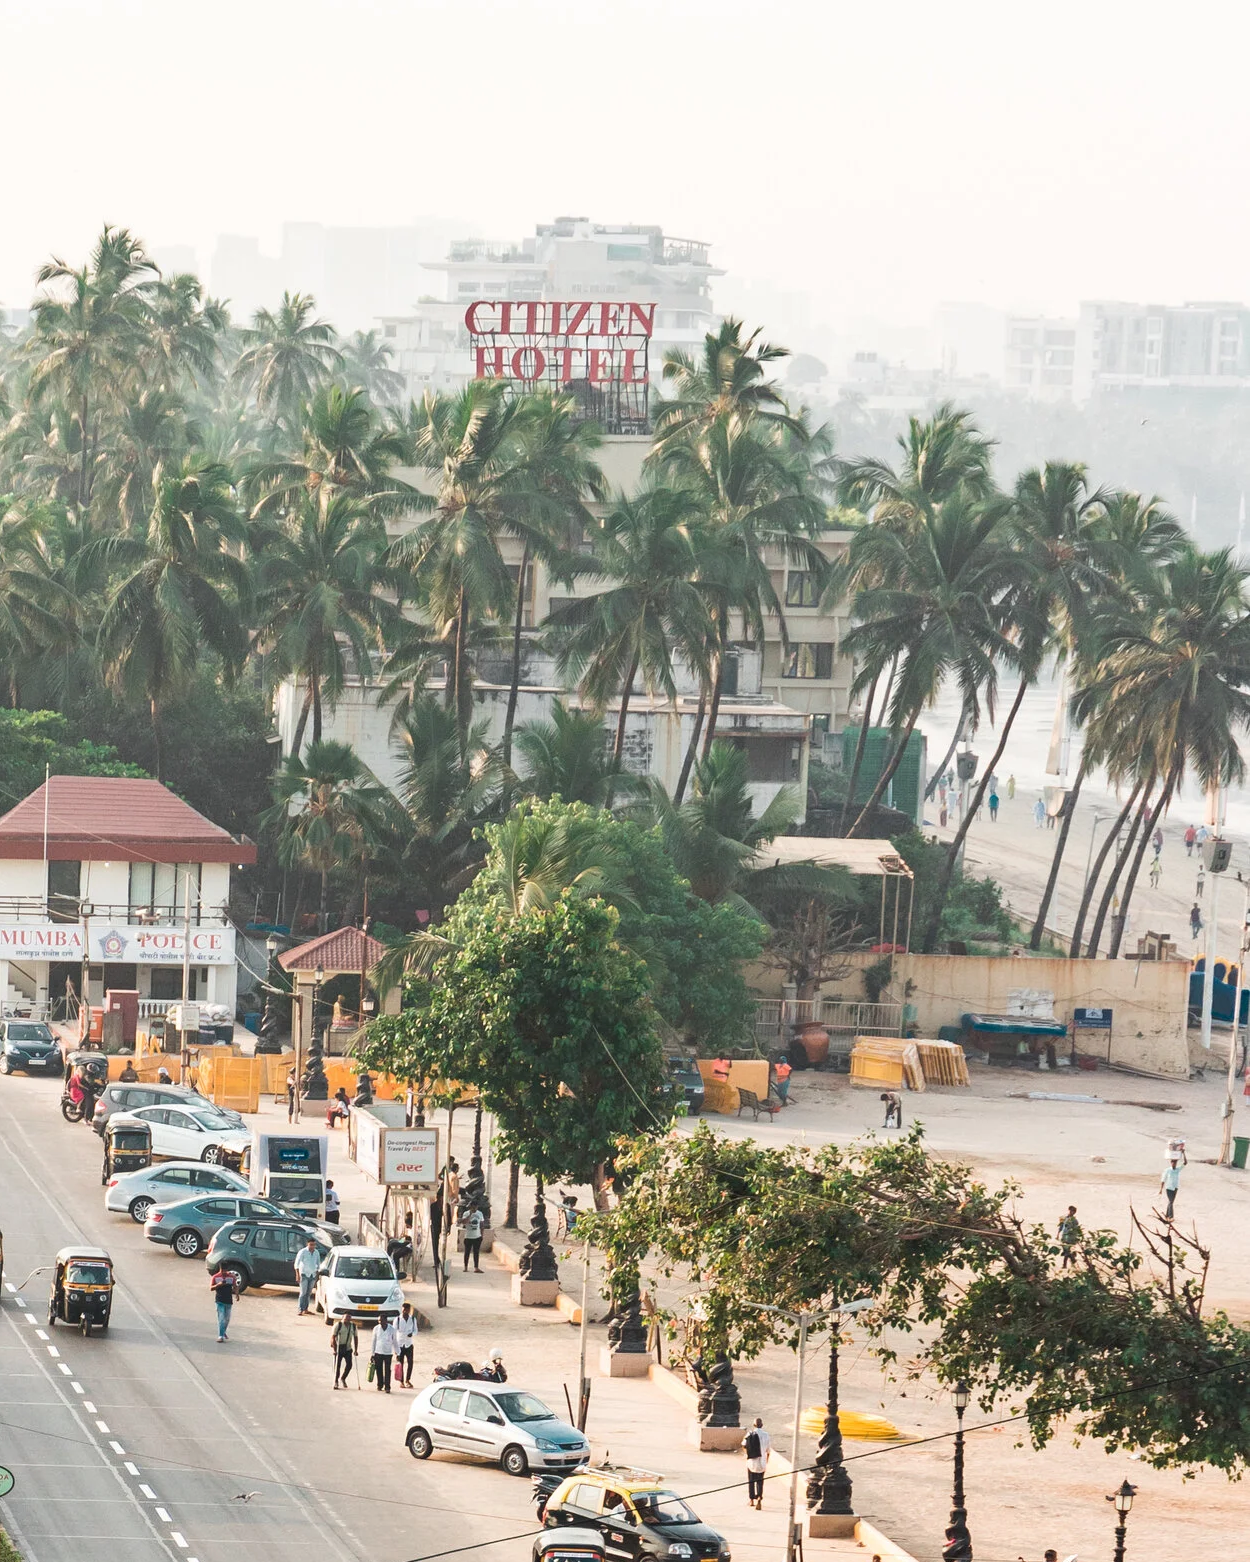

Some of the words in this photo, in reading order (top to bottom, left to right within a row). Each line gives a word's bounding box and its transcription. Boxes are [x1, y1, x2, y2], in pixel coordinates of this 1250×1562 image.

[464, 300, 659, 337] CITIZEN
[474, 346, 650, 384] HOTEL
[0, 929, 86, 947] MUMBA
[140, 932, 222, 950] POLCE
